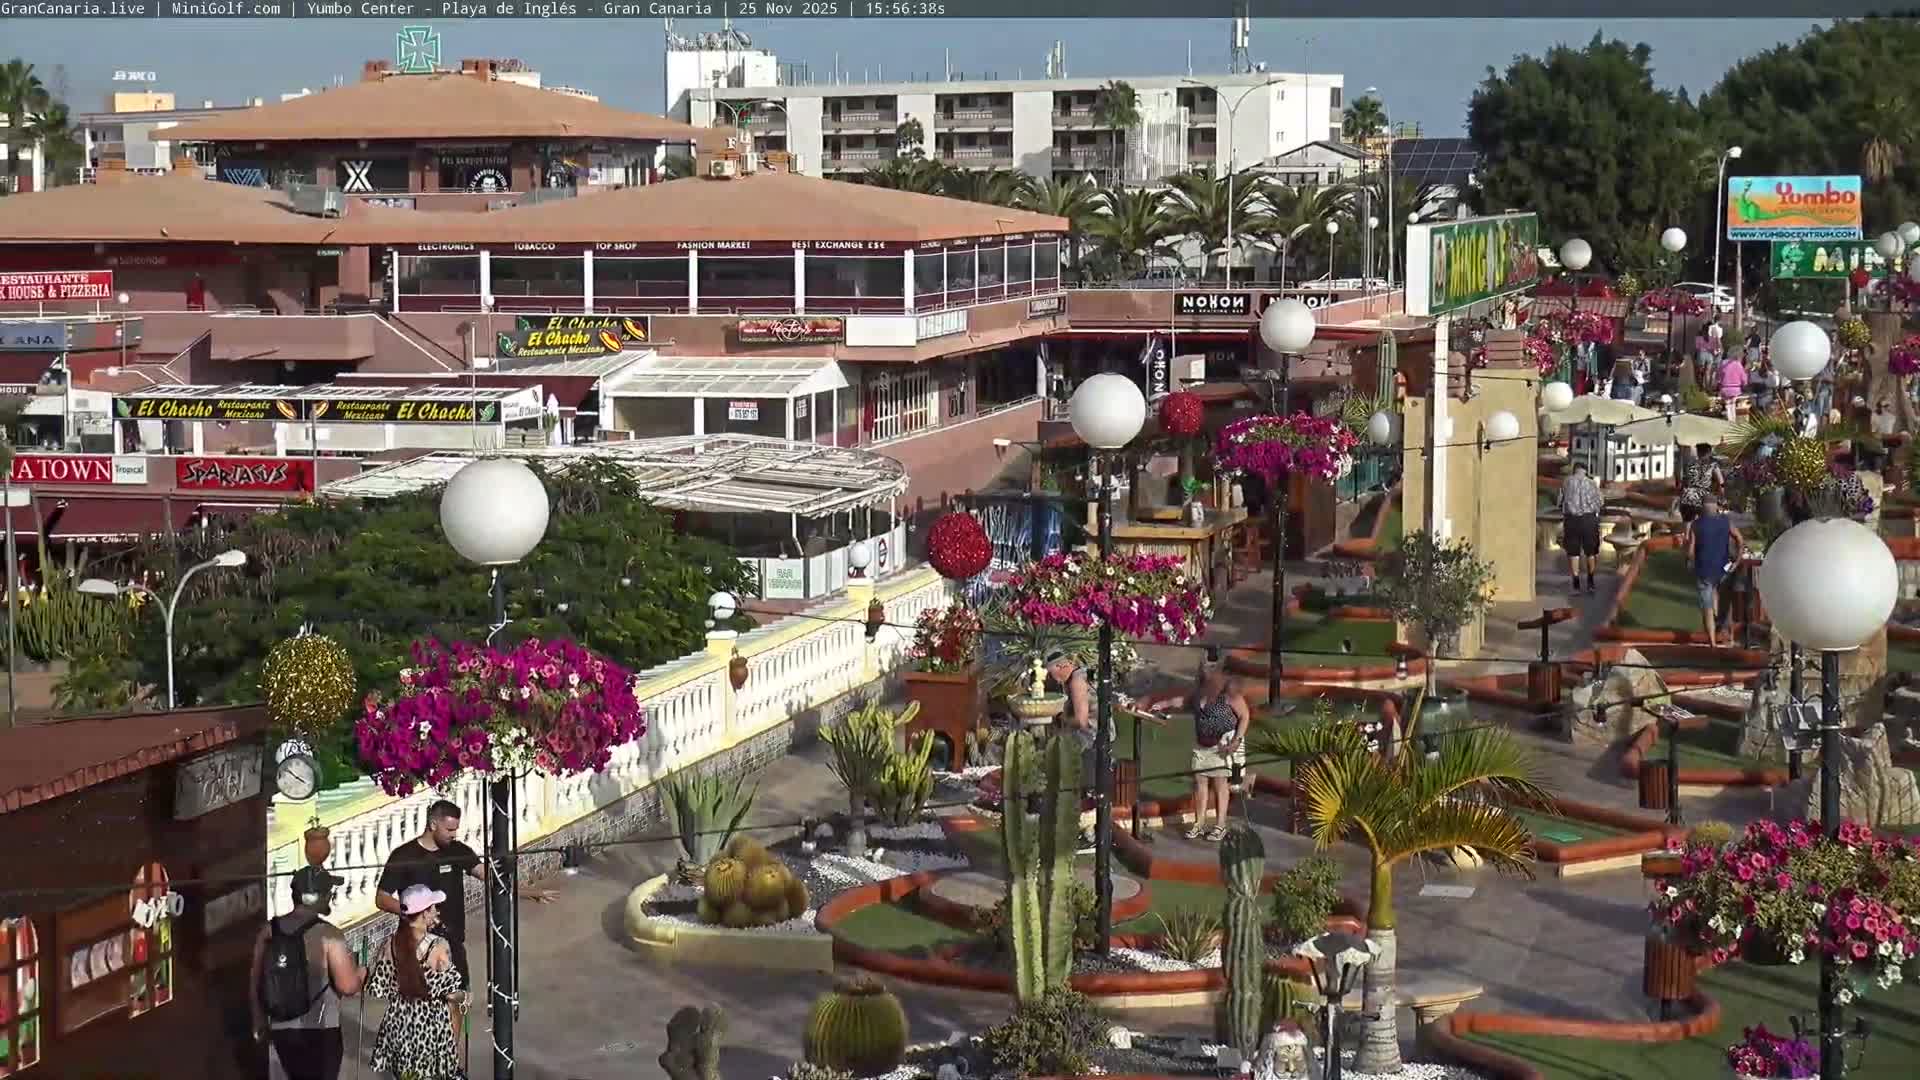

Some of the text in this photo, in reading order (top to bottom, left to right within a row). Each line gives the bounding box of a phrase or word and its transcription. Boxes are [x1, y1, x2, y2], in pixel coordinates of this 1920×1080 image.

[1776, 180, 1856, 205] Yumbo
[1731, 230, 1857, 239] WWW.YUMBOCENTRUM.COM
[0, 275, 89, 284] ESTAURANTE
[8, 286, 44, 299] HOUSE
[48, 285, 57, 298] &
[60, 284, 110, 297] PIZZERIA
[528, 330, 591, 347] El Chacho
[518, 347, 565, 357] Restaurante
[137, 400, 213, 417] El Chacho
[217, 400, 271, 410] Restaurante
[336, 401, 390, 411] Restaurante
[224, 410, 265, 419] Mexicano
[344, 411, 385, 420] Mexicano
[397, 401, 475, 420] El Chacho
